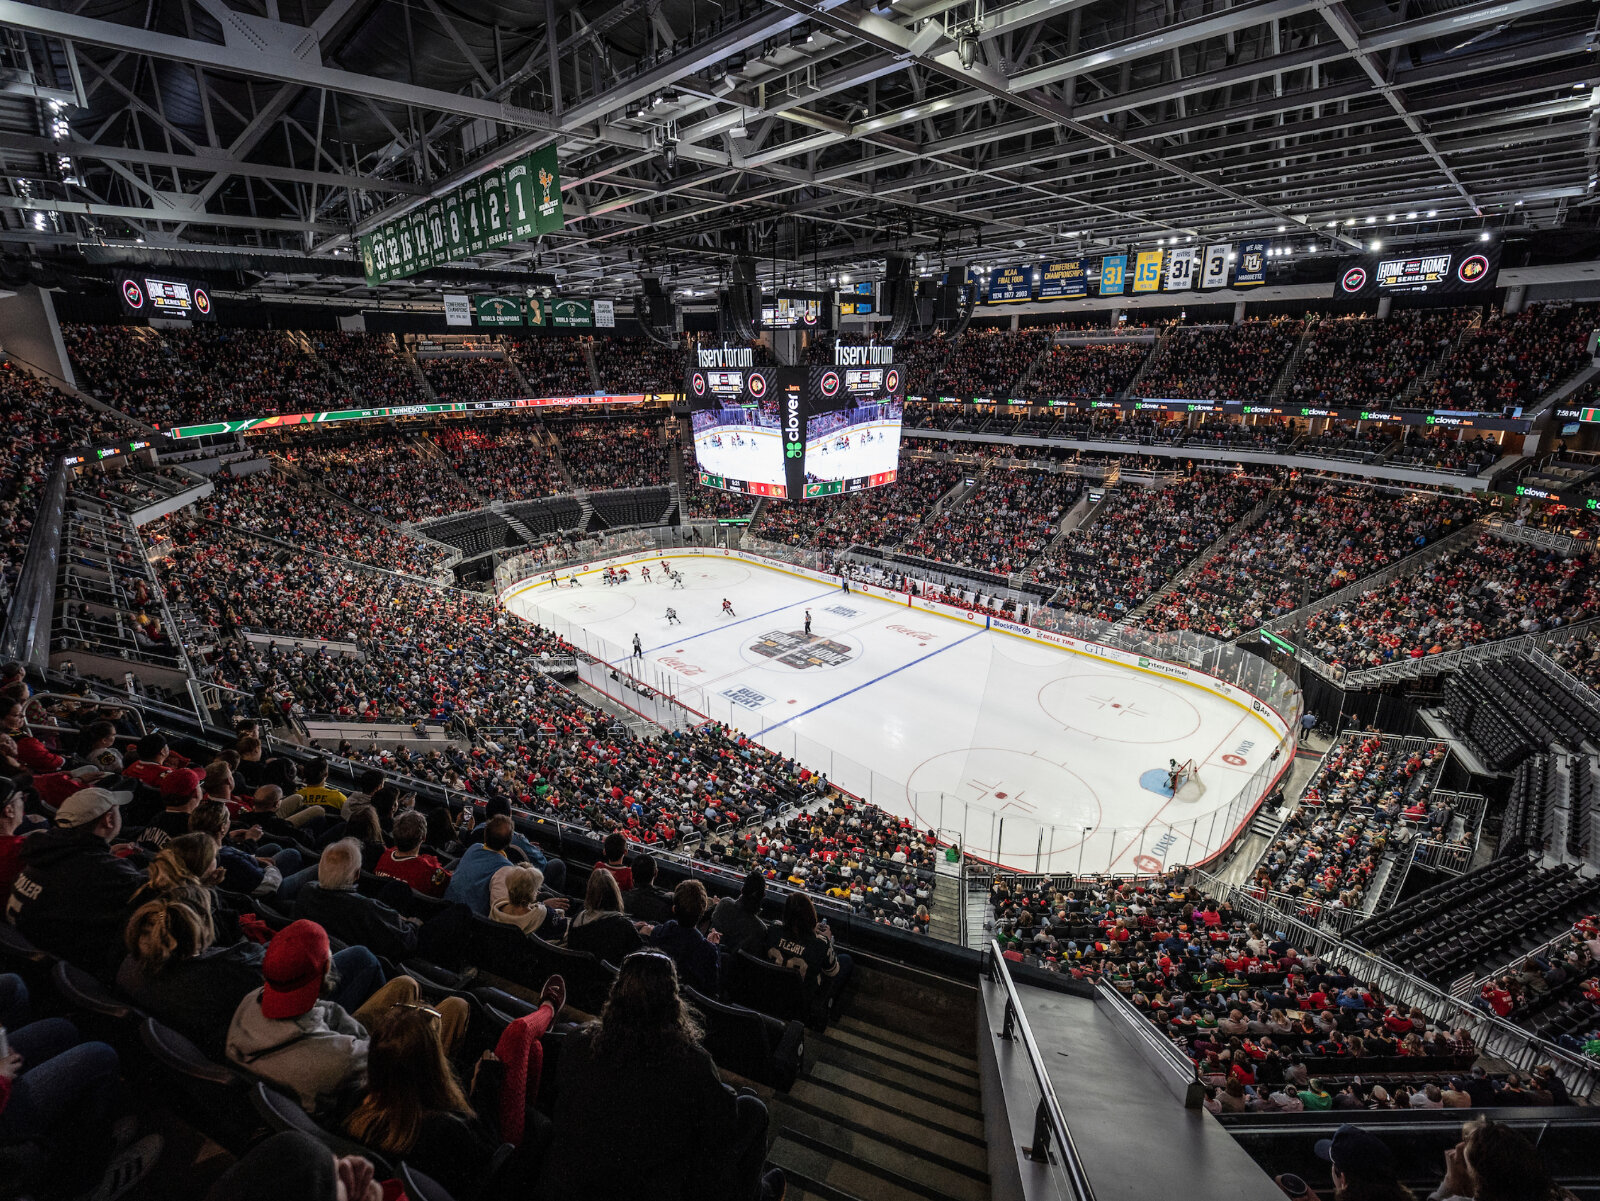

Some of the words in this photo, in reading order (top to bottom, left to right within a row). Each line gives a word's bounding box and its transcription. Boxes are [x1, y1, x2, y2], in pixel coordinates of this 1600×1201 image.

[516, 182, 526, 220] 1
[470, 202, 480, 237] 4
[489, 193, 500, 230] 2
[430, 217, 443, 250] 10
[450, 210, 460, 243] 8
[400, 232, 412, 261] 16
[415, 224, 428, 256] 14
[374, 243, 386, 270] 33
[387, 237, 400, 266] 32
[1044, 270, 1084, 280] CHAMPIONSHIPS
[1049, 262, 1079, 271] CONFERENCE
[1104, 266, 1122, 285] 31
[1137, 263, 1158, 281] 15
[1172, 259, 1190, 278] 31
[1210, 256, 1224, 276] 3
[1380, 262, 1406, 278] HOME
[1421, 258, 1448, 274] HOME
[1397, 274, 1425, 282] SERIES
[785, 394, 799, 441] clover
[1435, 417, 1460, 425] clover
[1524, 488, 1548, 498] clover
[993, 620, 1022, 633] BlockFills
[1043, 634, 1061, 642] BELLE
[1084, 643, 1107, 657] GTL
[722, 689, 762, 708] LIGHT
[737, 688, 765, 702] BUD
[1235, 740, 1255, 756] BMO
[1151, 833, 1178, 856] BMO
[778, 938, 805, 956] FLEURY
